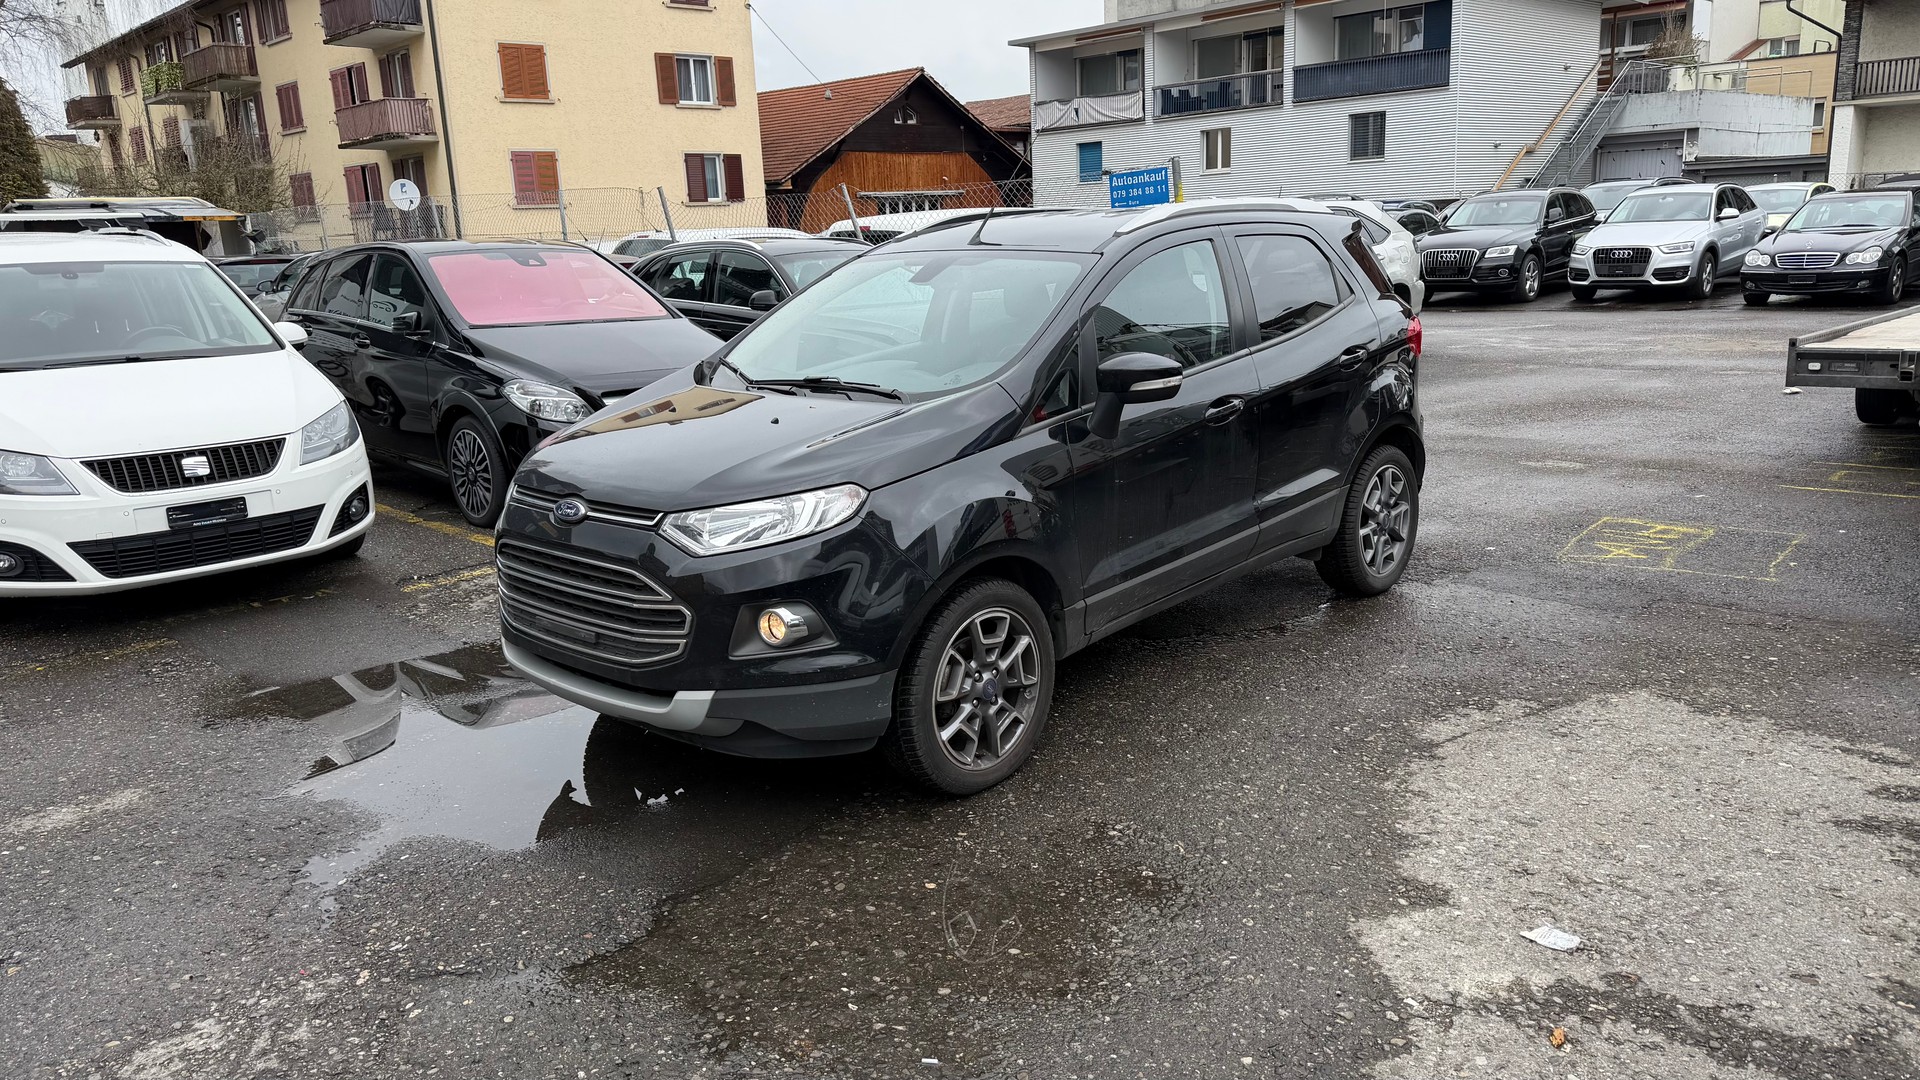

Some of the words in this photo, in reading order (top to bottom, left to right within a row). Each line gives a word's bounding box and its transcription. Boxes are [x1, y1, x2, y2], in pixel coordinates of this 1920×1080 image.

[1112, 170, 1166, 187] Autoankauf
[1113, 190, 1126, 199] 079
[1129, 188, 1142, 197] 384
[558, 502, 577, 516] Ford
